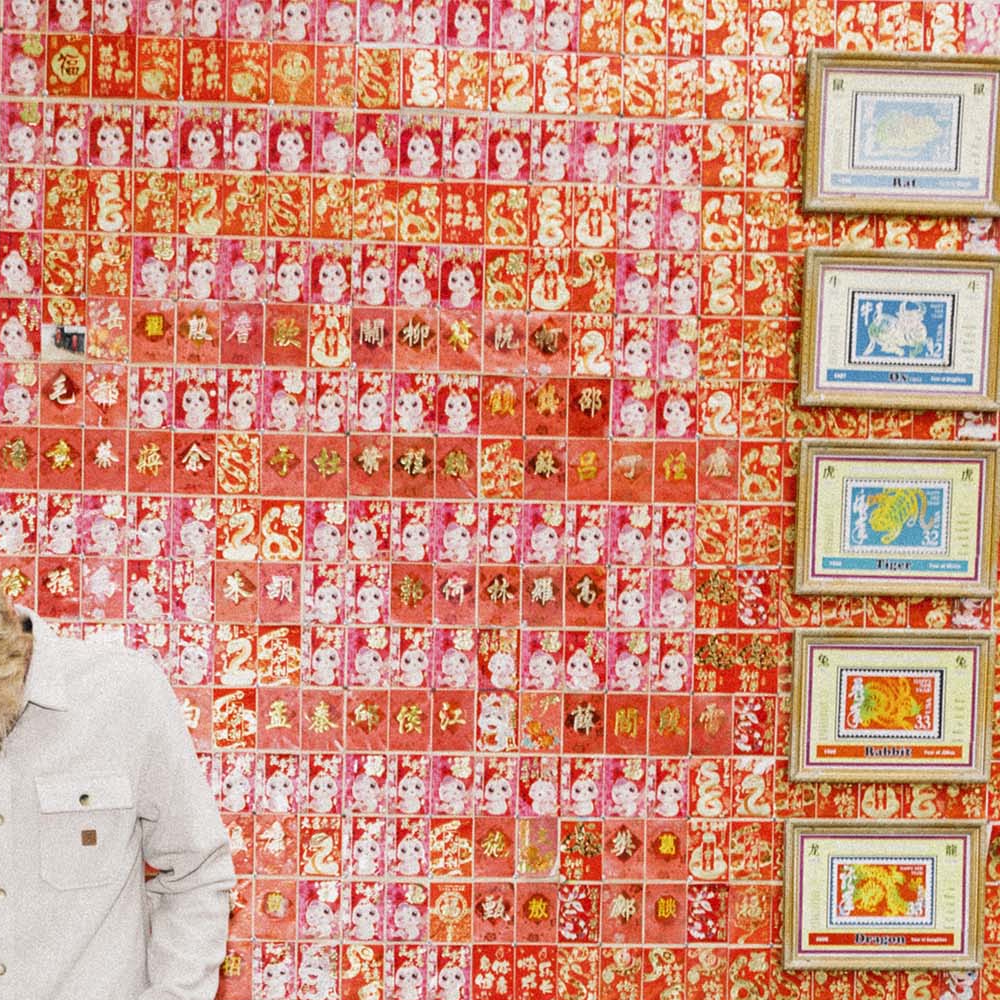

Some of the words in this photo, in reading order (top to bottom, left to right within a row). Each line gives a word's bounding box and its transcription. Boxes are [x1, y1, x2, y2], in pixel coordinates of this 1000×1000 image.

[58, 52, 80, 75] 福
[893, 177, 917, 188] Rat
[402, 316, 430, 347] 柳
[49, 373, 76, 405] 毛
[579, 386, 602, 418] 邵
[182, 443, 211, 472] 余
[577, 450, 598, 480] 呂
[921, 530, 939, 545] 32
[876, 559, 912, 571] Tiger
[47, 567, 75, 596] 孫
[222, 571, 252, 604] 朱
[266, 575, 294, 602] 胡
[442, 577, 469, 605] 何
[487, 577, 515, 604] 林
[574, 575, 598, 605] 高
[265, 701, 292, 730] 孟
[308, 701, 339, 733] 秦
[440, 702, 476, 731] 江
[572, 702, 596, 736] 薛
[914, 714, 931, 729] 33
[864, 746, 912, 757] Rabbit
[482, 830, 509, 858] 施
[659, 834, 676, 854] 葛
[854, 933, 906, 946] Dragon
